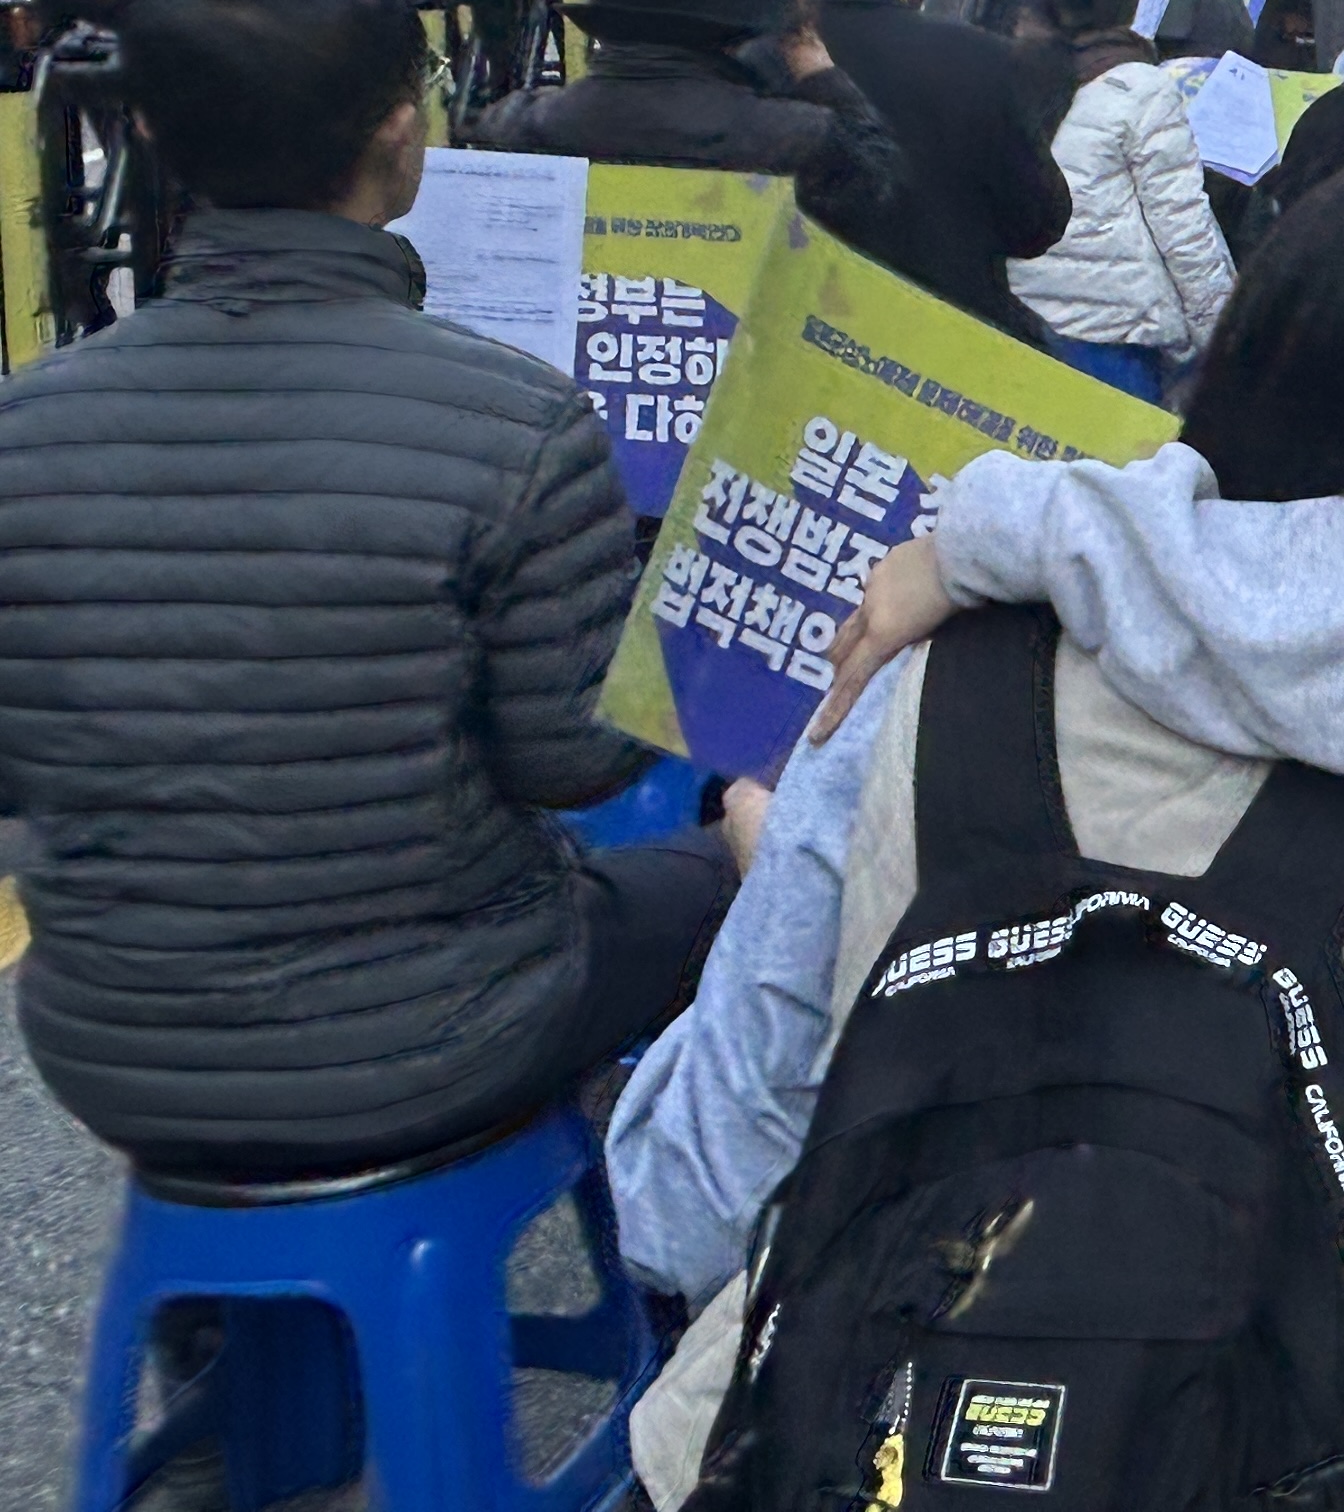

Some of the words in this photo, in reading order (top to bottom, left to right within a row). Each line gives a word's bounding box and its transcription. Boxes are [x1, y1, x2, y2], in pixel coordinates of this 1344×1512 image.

[790, 416, 909, 522] 일본
[1160, 901, 1267, 966] GUESS
[1272, 967, 1328, 1069] GUESS
